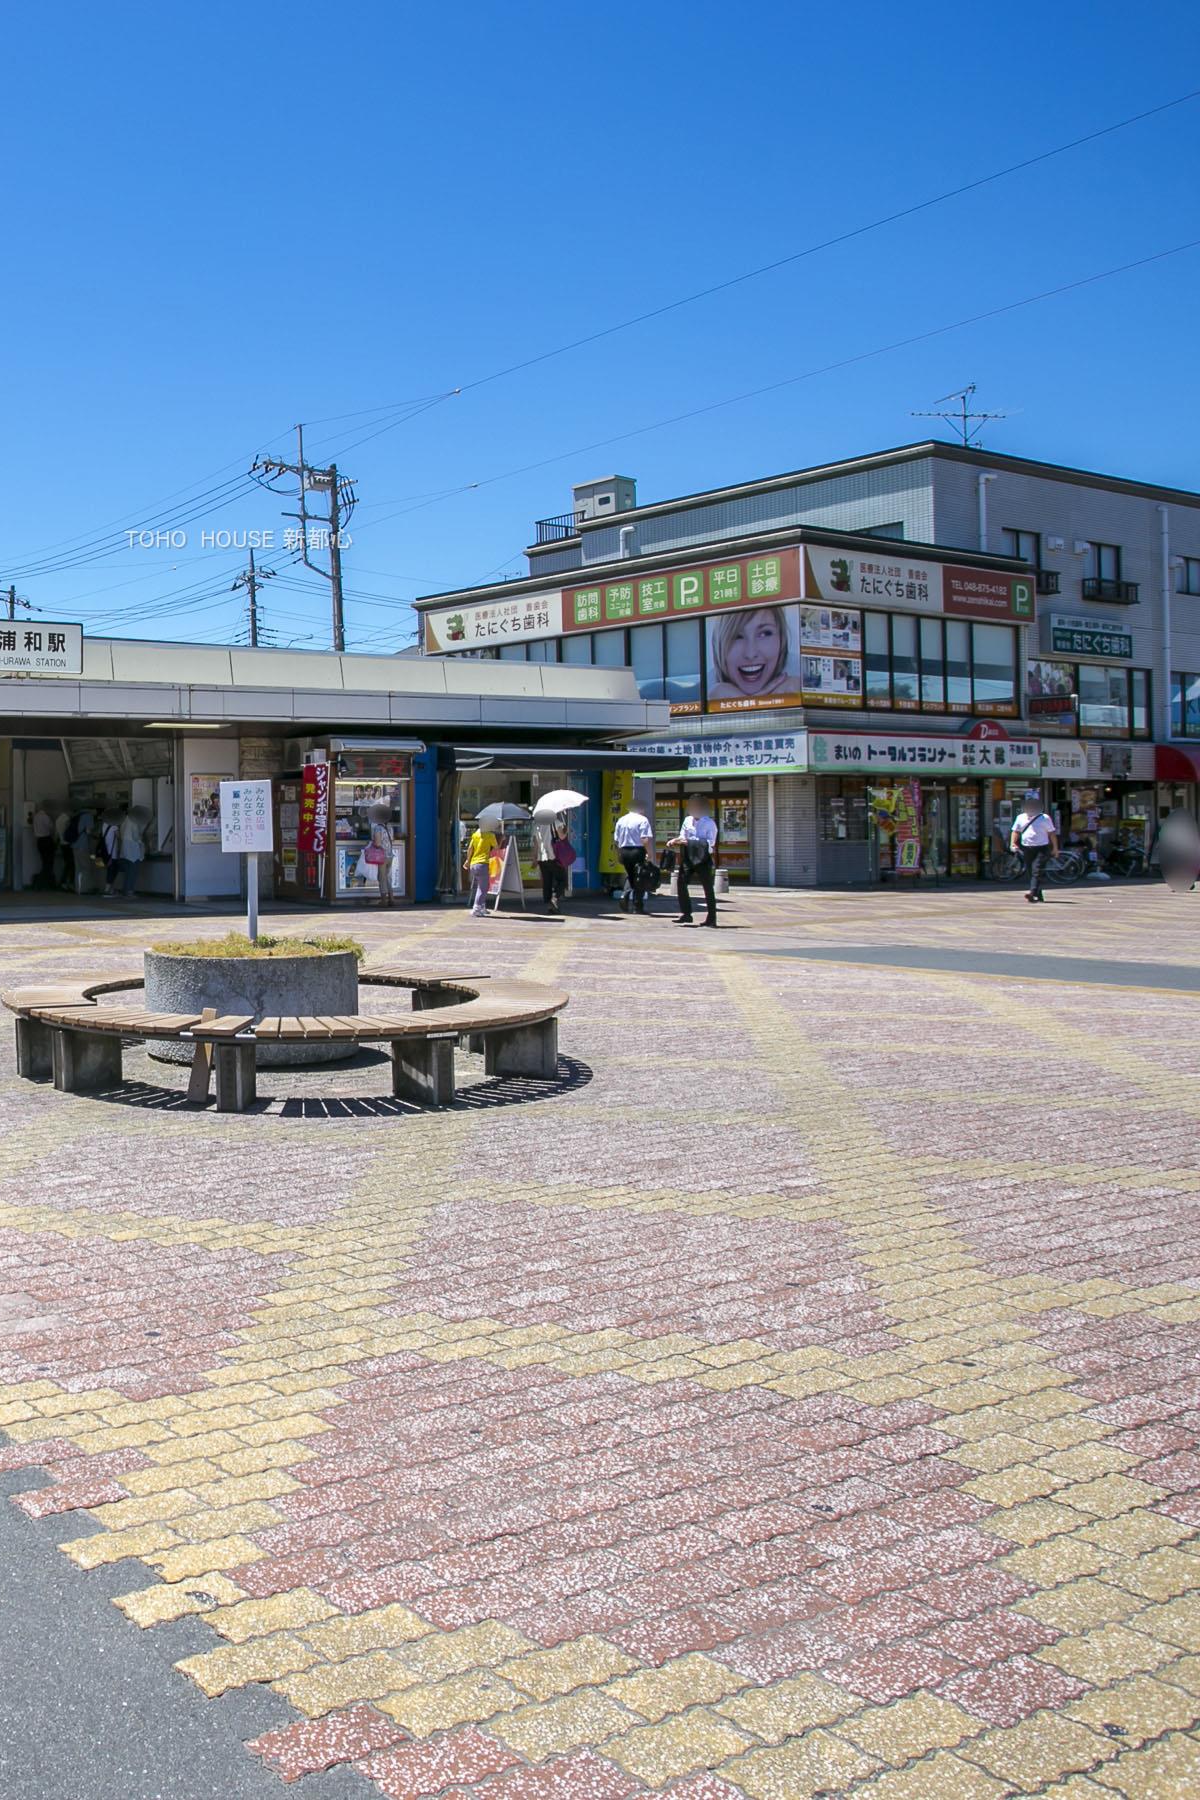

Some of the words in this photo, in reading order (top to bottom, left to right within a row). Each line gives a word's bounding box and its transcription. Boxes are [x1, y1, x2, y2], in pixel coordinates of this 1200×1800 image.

[713, 568, 738, 585] 平日
[751, 561, 777, 578] 土日
[860, 562, 902, 578] 医療法人社団
[642, 581, 665, 597] 技工
[680, 576, 698, 606] P
[751, 576, 777, 594] 診療
[860, 577, 929, 602] たにぐち歯科
[951, 579, 963, 590] TEL
[577, 591, 598, 608] 訪問
[608, 586, 631, 602] 予防
[714, 588, 733, 599] 21時
[1016, 584, 1029, 612] P
[609, 602, 631, 610] ユニット
[642, 597, 653, 611] 室
[475, 605, 518, 621] 医療法人社団
[577, 606, 598, 622] 歯科
[474, 611, 550, 637] たにぐち歯科
[35, 657, 67, 667] STATION
[867, 744, 957, 763] トータルプランナー
[313, 766, 328, 854] ジャンボ宝くじ
